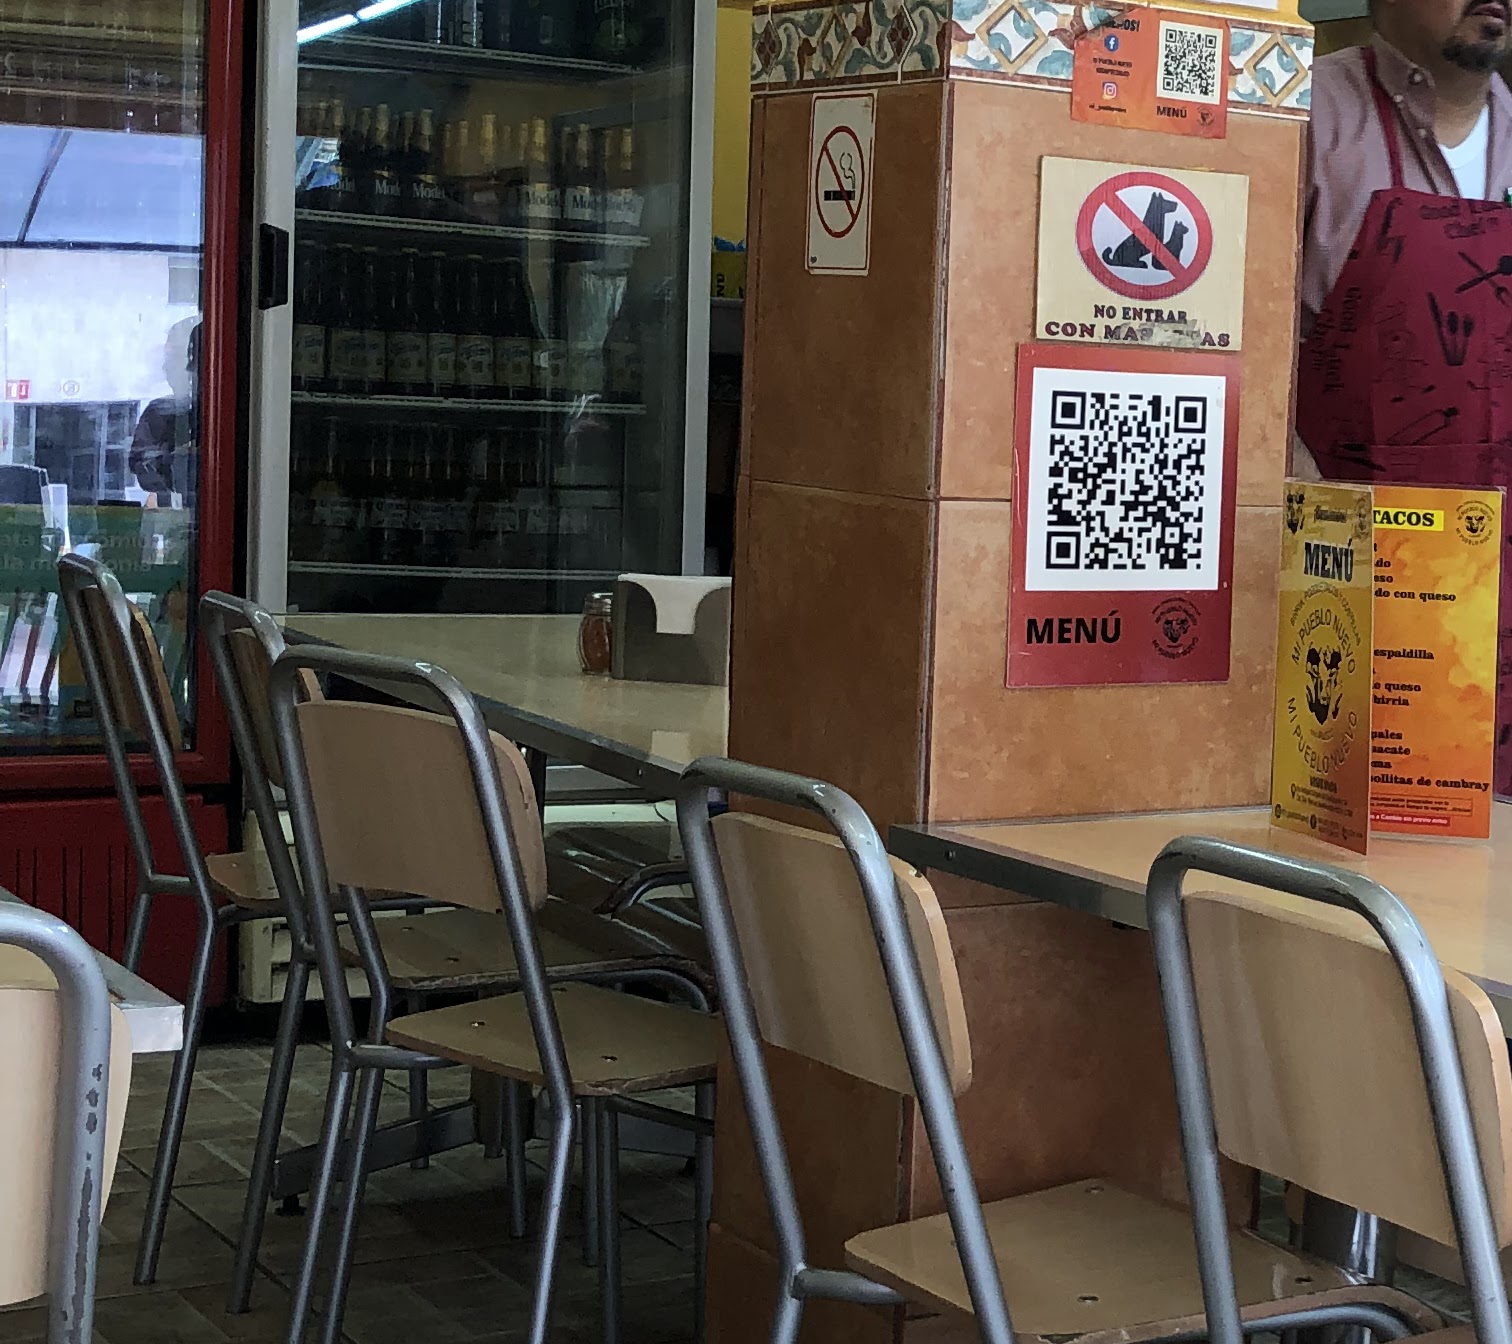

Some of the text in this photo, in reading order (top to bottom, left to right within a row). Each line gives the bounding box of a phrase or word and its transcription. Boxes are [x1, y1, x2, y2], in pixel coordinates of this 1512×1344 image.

[1094, 304, 1188, 324] NO ENTRAR
[1045, 321, 1230, 347] CON MASAS
[1373, 509, 1435, 527] TACOS
[1304, 538, 1354, 583] MENÚ
[1394, 590, 1416, 600] con
[1419, 592, 1457, 603] queso
[1026, 609, 1122, 645] MENÚ
[1298, 608, 1332, 646] PUEBLO
[1384, 682, 1422, 693] queso
[1293, 725, 1330, 774] PUEBLO
[1417, 776, 1432, 787] de
[1435, 779, 1490, 792] cambray
